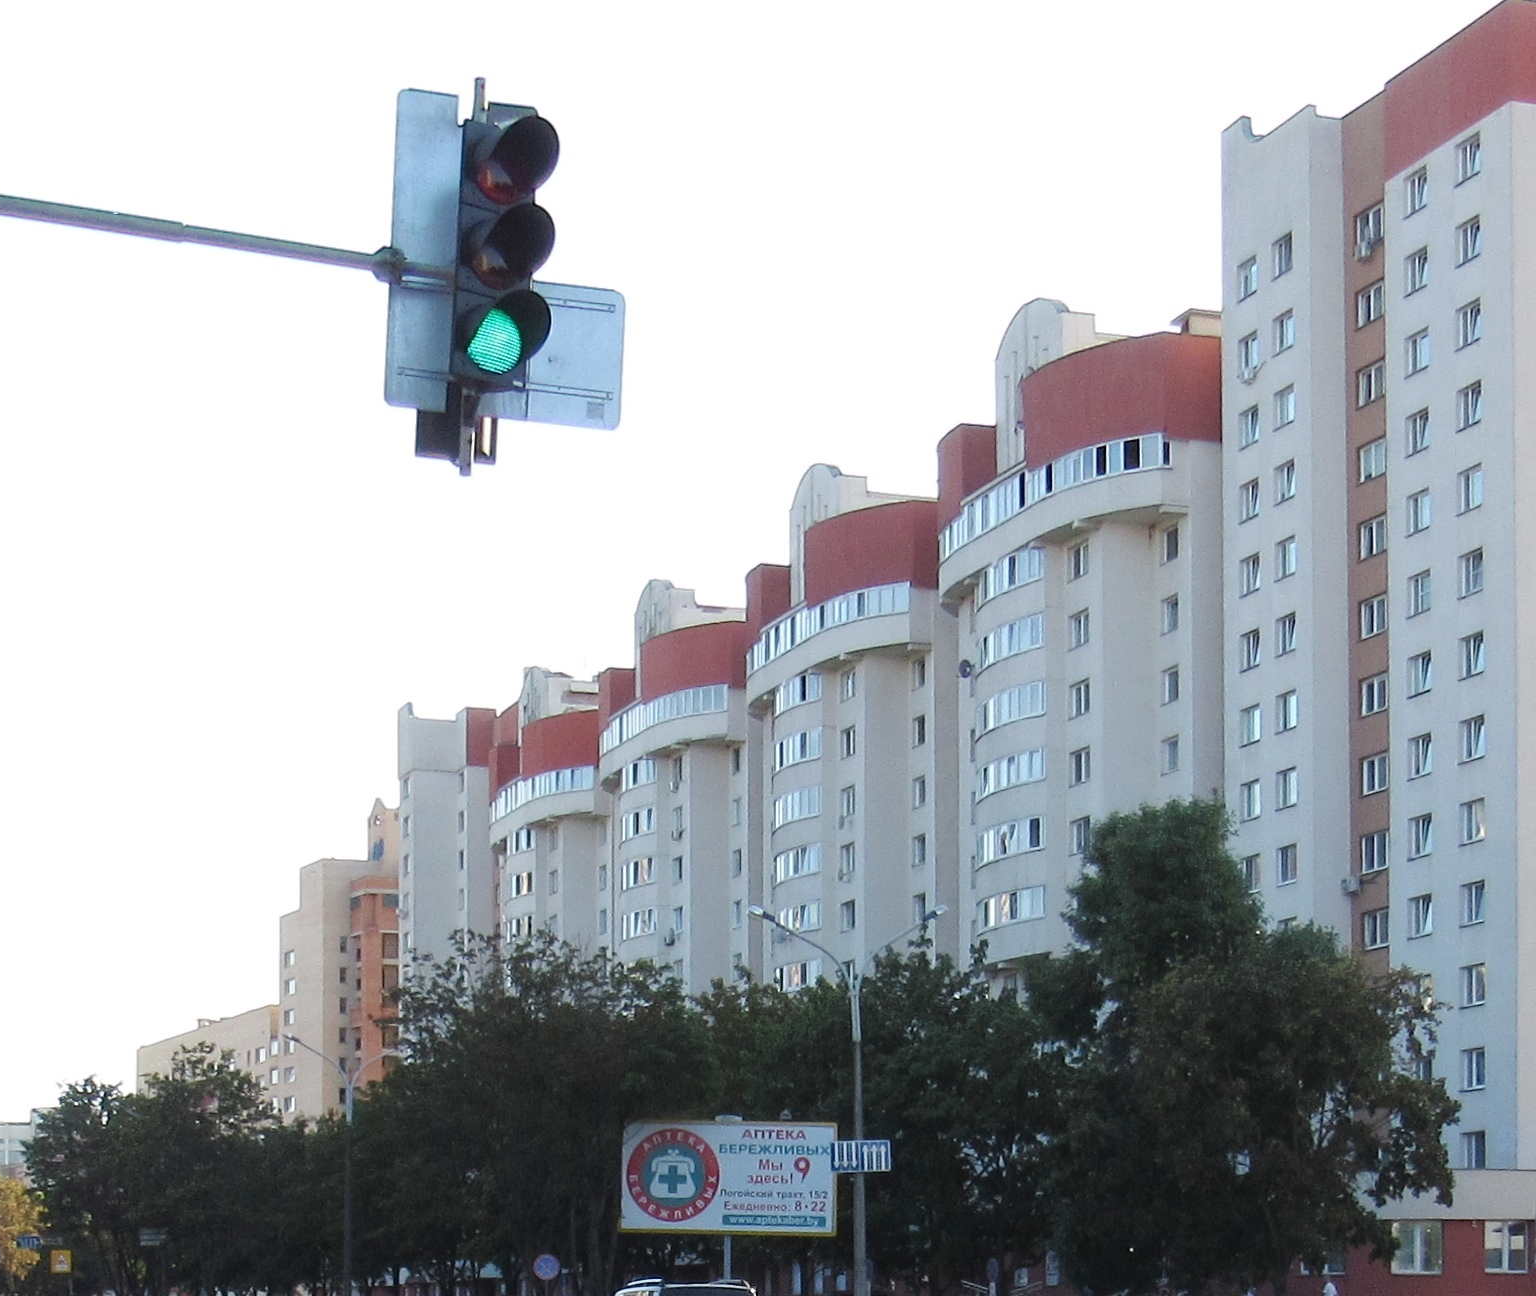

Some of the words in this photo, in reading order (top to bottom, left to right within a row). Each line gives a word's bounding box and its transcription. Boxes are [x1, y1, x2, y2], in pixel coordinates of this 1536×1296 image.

[741, 1129, 807, 1140] АПТЕКА
[643, 1131, 705, 1154] АПТЕКА
[718, 1143, 831, 1156] БЕРЕЖЛИВЫХ
[758, 1159, 783, 1171] Мы
[747, 1173, 793, 1186] здесь!
[629, 1174, 718, 1219] БЕРЕЖЛИВЫХ
[723, 1201, 792, 1212] Ежедневно:
[728, 1216, 820, 1227] www.aptekaber.by
